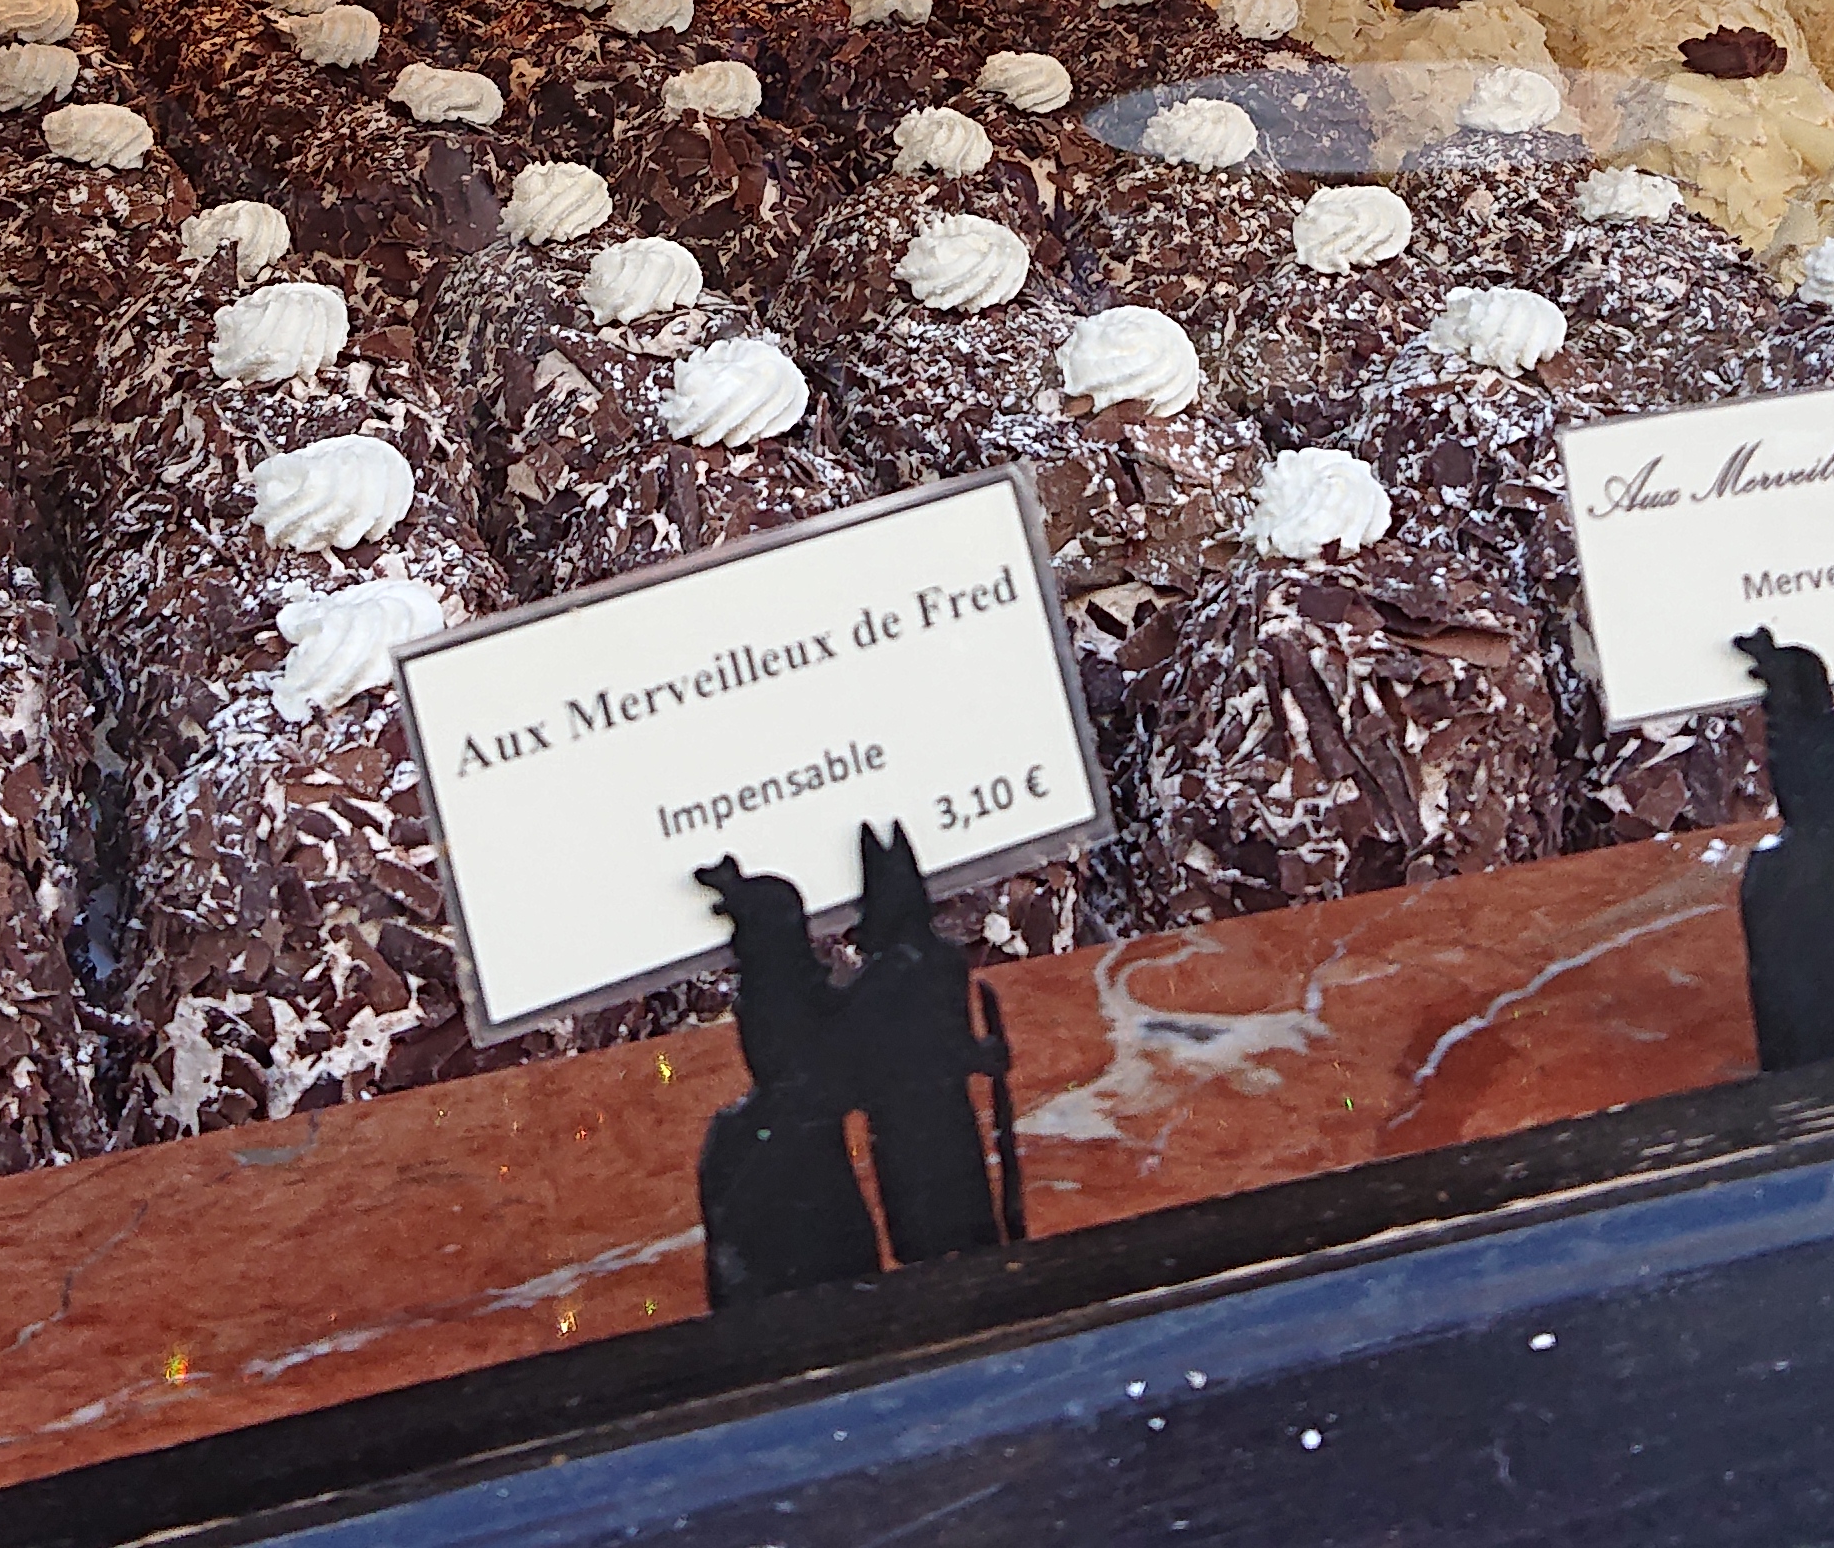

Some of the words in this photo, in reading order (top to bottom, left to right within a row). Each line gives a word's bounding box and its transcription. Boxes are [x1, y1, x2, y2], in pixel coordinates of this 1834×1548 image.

[1588, 454, 1682, 518] Aux
[455, 722, 553, 778] Aux
[564, 630, 838, 744] Merveilleux
[851, 607, 904, 652] de
[914, 566, 1019, 632] Fred
[657, 739, 888, 840] Impensable
[933, 777, 1015, 833] 3,10
[1024, 766, 1052, 801] €
